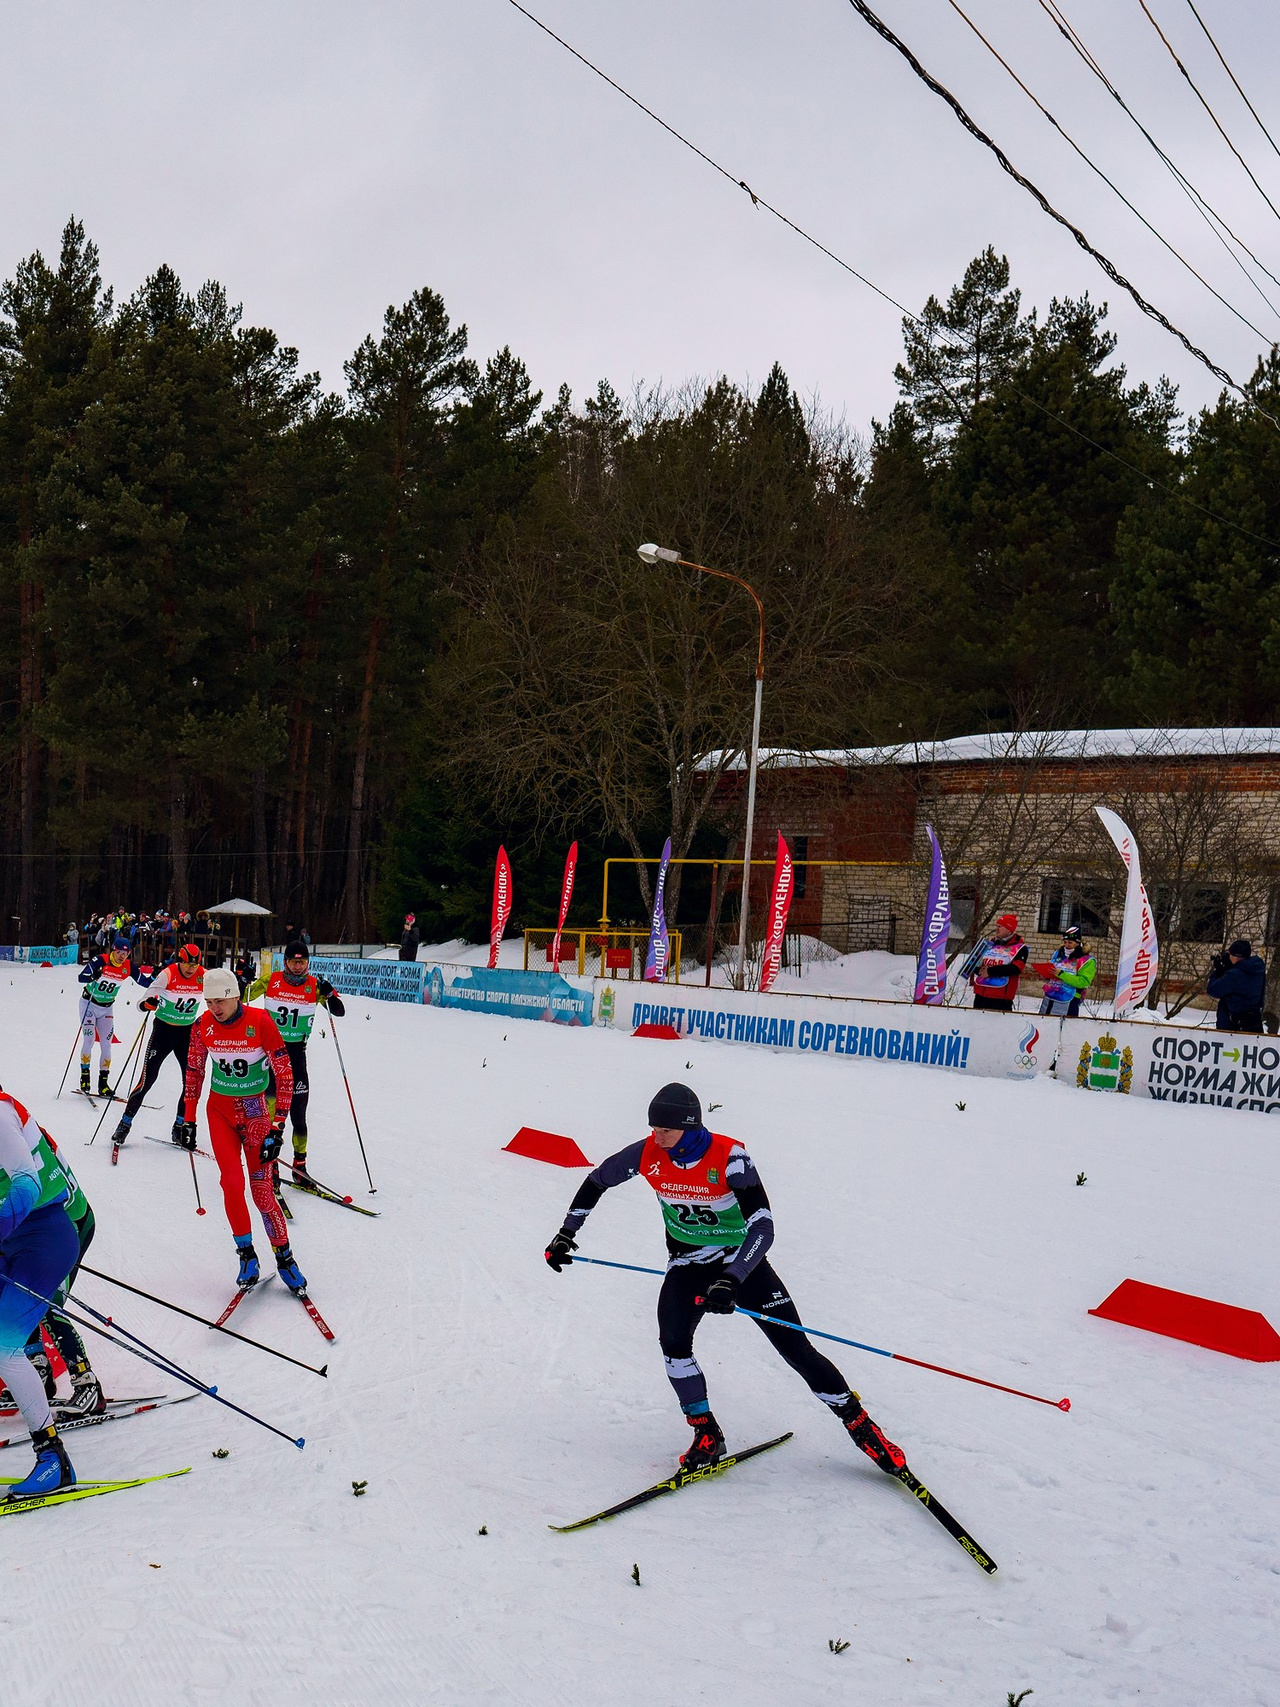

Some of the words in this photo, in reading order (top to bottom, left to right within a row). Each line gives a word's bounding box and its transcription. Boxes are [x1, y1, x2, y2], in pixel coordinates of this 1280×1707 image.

[923, 948, 940, 995] СШОР
[97, 980, 117, 994] 68
[174, 997, 197, 1013] 42
[486, 990, 510, 1004] СПОРТА
[510, 994, 550, 1009] КАЛУЖСКОЙ
[551, 998, 585, 1013] ОБЛАСТИ
[275, 1005, 299, 1028] 31
[213, 1039, 248, 1047] ФЕДЕРАЦИЯ
[686, 1008, 795, 1048] УЧАСТНИКАМ
[798, 1020, 971, 1069] СОРЕВНОВАНИЙ!
[1152, 1036, 1224, 1065] СПОРТ
[218, 1058, 249, 1078] 49
[1148, 1061, 1243, 1092] НОРМА
[660, 1182, 710, 1194] ФЕДЕРАЦИЯ
[670, 1203, 720, 1226] 25
[743, 1234, 764, 1263] NORDSKI
[56, 1413, 116, 1431] MADSHUS
[36, 1461, 61, 1483] SPINE
[681, 1457, 737, 1486] FISCHER
[2, 1498, 46, 1513] FISCHER
[957, 1535, 990, 1569] FISCHER
